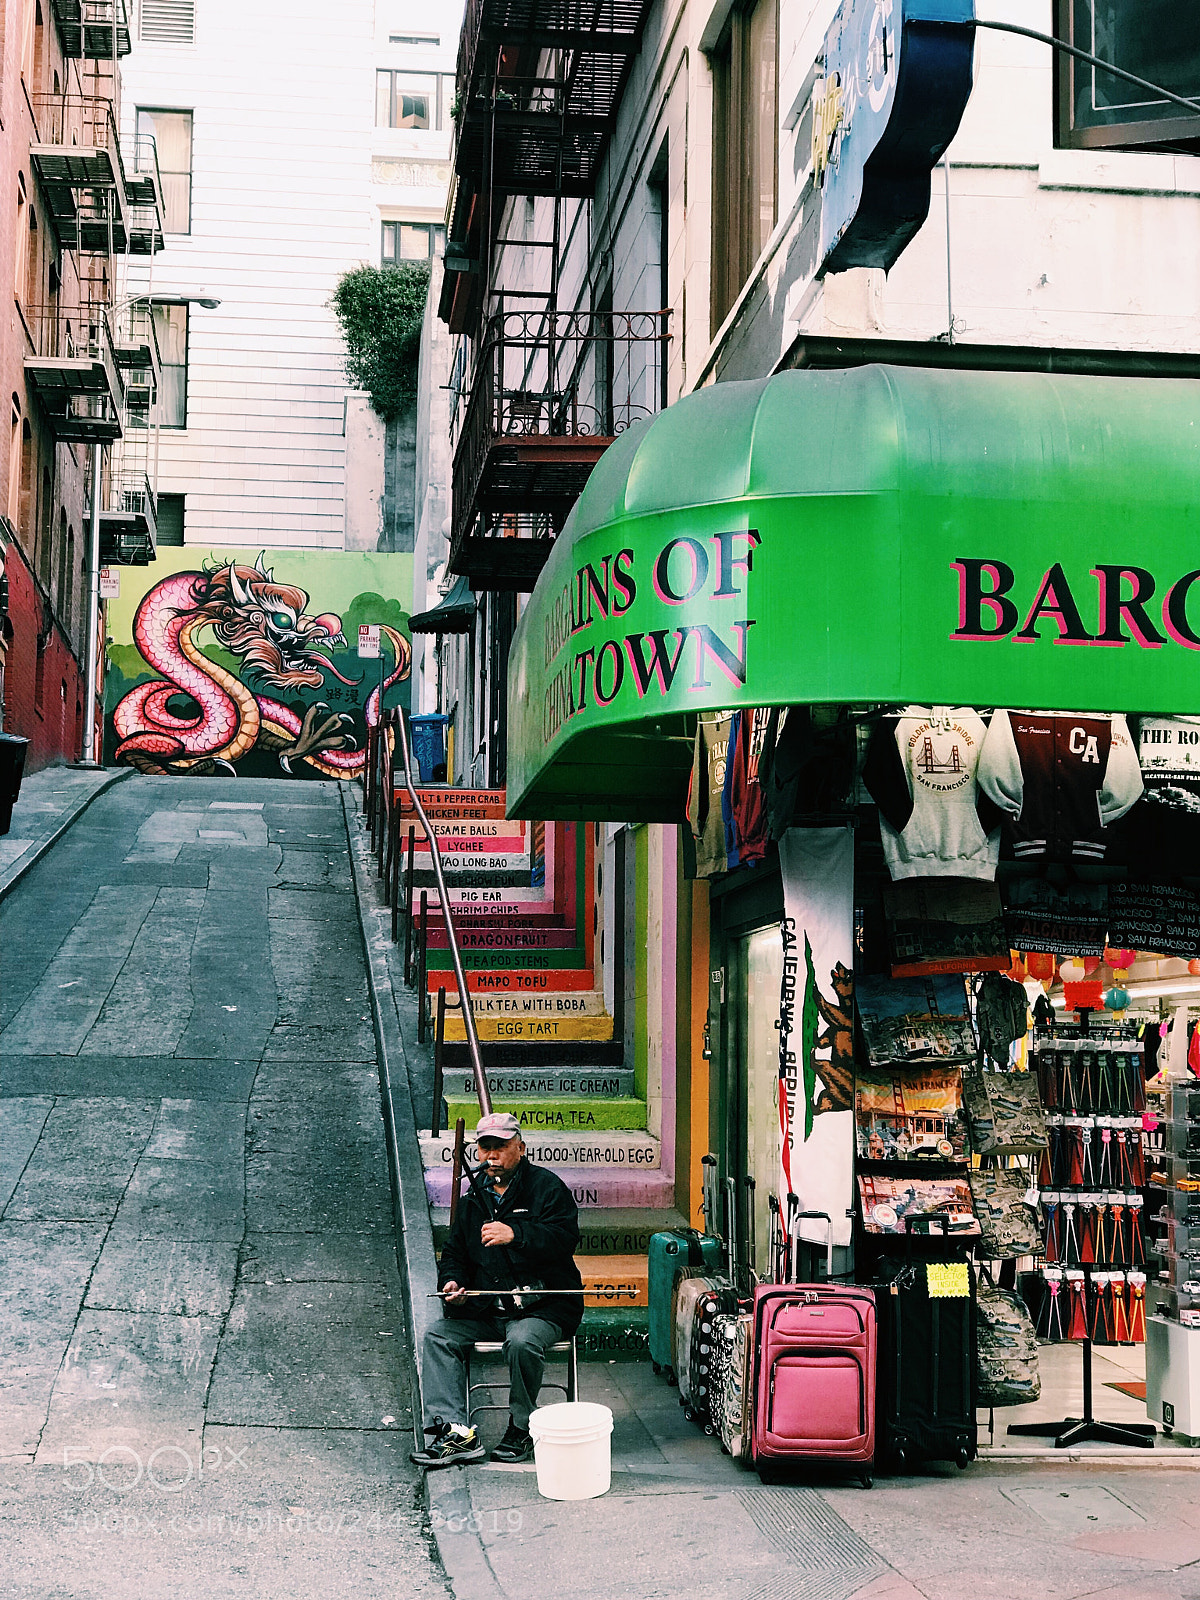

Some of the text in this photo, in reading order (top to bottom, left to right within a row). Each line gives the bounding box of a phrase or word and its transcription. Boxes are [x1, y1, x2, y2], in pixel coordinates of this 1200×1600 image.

[652, 529, 762, 606] OF
[360, 626, 368, 634] NO
[908, 723, 930, 748] GOLDEN
[1142, 729, 1172, 744] THE
[1069, 727, 1100, 764] CA
[916, 773, 970, 792] SAN FRANCISCO
[444, 794, 476, 804] PEPPER
[477, 795, 500, 804] CRAB
[425, 809, 487, 819] HICKEN FEET
[470, 825, 498, 836] BALLS
[447, 841, 484, 851] LYCHEE
[462, 857, 488, 867] LONG
[489, 858, 508, 868] BAO
[461, 892, 502, 901] PIG EAR
[450, 905, 519, 914] SHRIMP CHIPS
[1021, 920, 1098, 942] ALCATRAZ
[1127, 933, 1147, 944] SAN
[1148, 936, 1197, 951] FRANCISCO
[514, 955, 550, 968] STEMS
[928, 961, 977, 971] CALIFORNIA
[477, 976, 547, 987] MAPO TOFU
[495, 1000, 519, 1011] TEA
[522, 999, 553, 1011] WITH
[556, 999, 587, 1011] BOBA
[497, 1022, 560, 1035] EGG TART
[464, 1078, 620, 1093] BLCK SESAME ICE CREAM
[569, 1111, 596, 1125] TEA
[1141, 1131, 1163, 1149] ALI
[628, 1148, 655, 1163] EGG
[578, 1234, 651, 1250] TICKY RIC
[593, 1284, 637, 1300] TOFU
